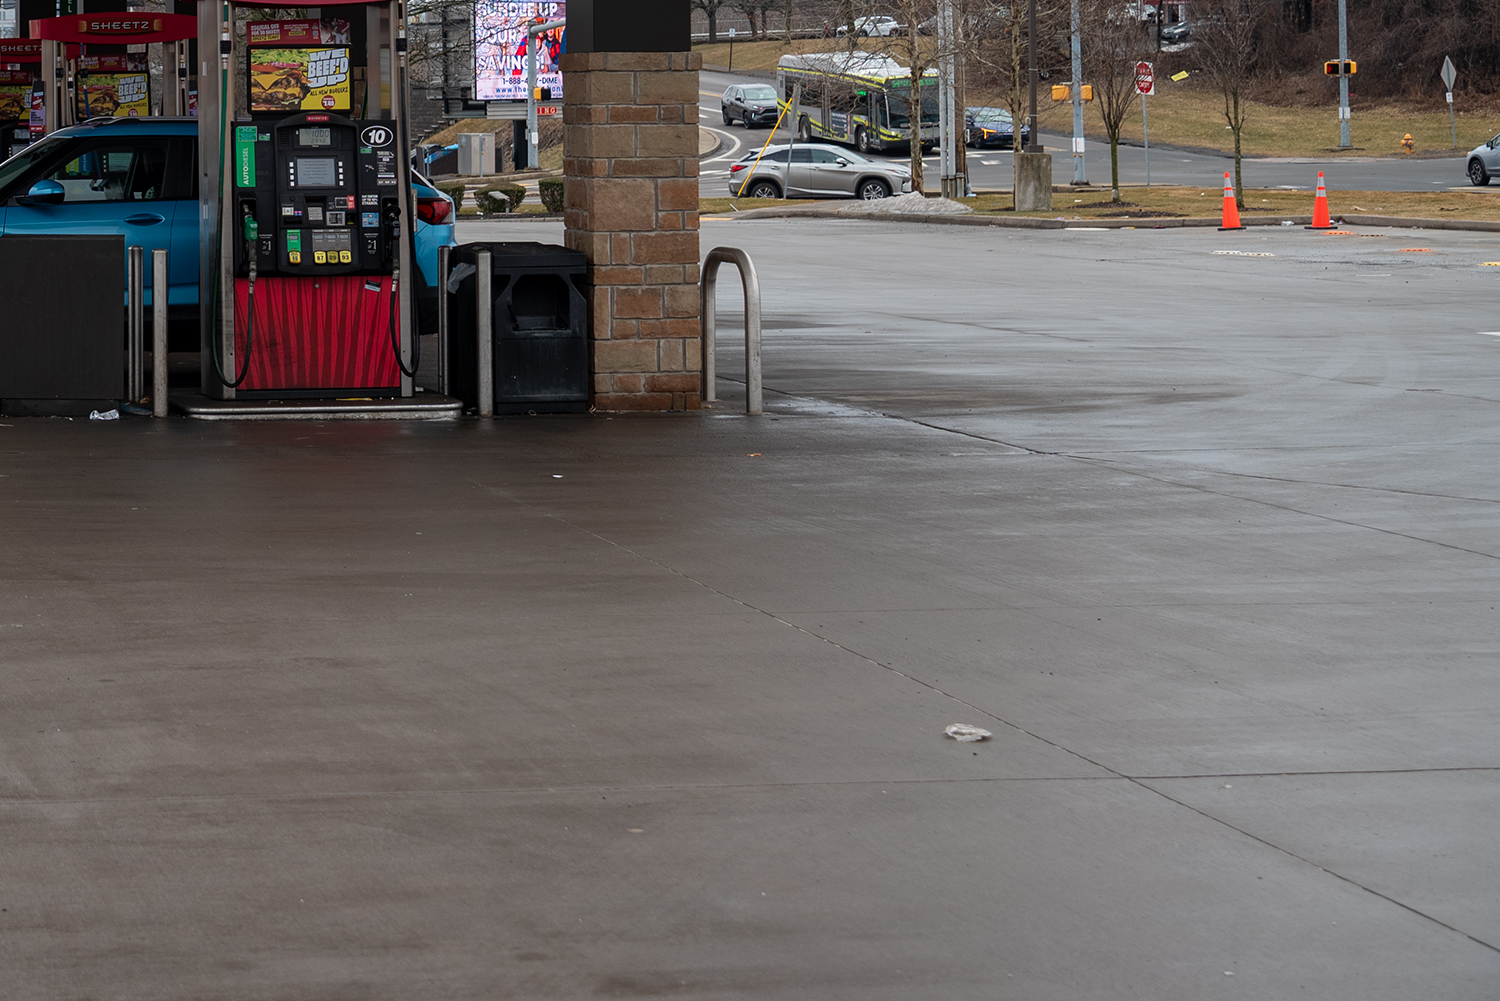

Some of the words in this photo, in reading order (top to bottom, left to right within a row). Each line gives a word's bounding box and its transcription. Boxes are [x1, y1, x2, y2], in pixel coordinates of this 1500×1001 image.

[477, 2, 535, 17] BUNDLE
[538, 2, 558, 17] UP
[91, 21, 149, 31] SHEETZ
[476, 28, 518, 43] YOUR
[310, 48, 346, 62] WE
[308, 57, 349, 78] BEEF'D
[119, 75, 145, 84] WE
[308, 74, 347, 88] UP
[118, 82, 147, 96] BEEF'D
[368, 130, 386, 144] 10
